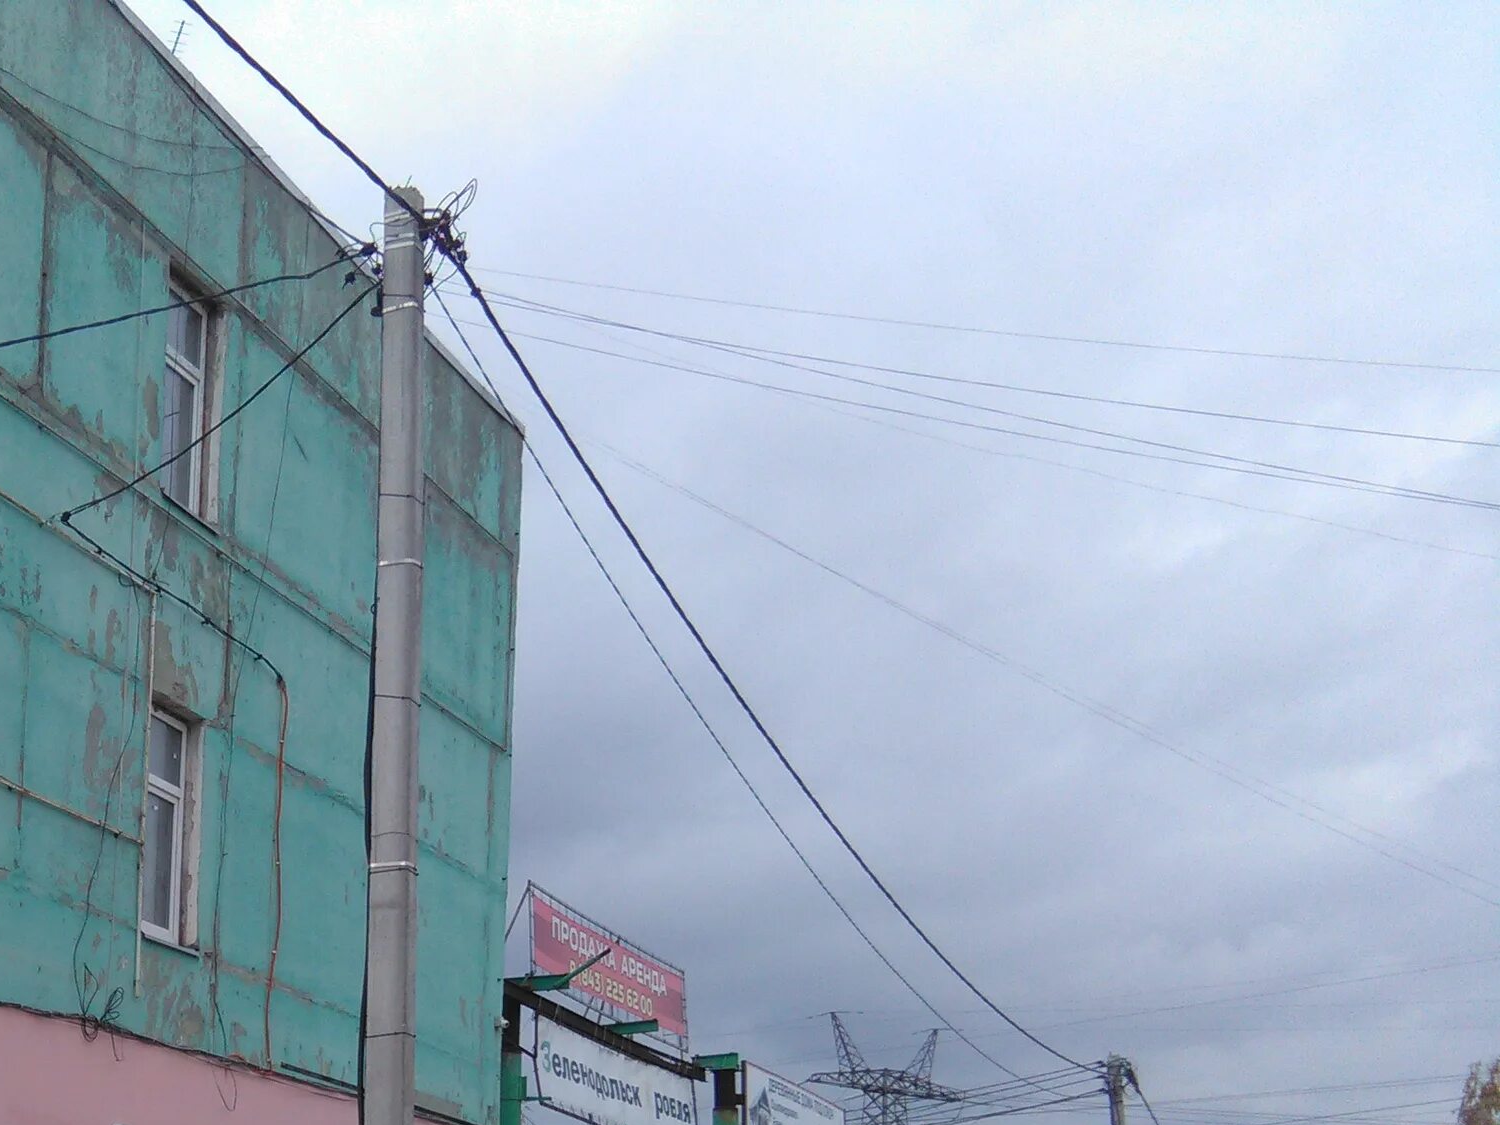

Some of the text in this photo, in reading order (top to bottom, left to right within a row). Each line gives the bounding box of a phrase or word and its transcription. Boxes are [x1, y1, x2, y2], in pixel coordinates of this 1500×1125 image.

[551, 915, 668, 997] ПРОДАЖА АРЕНДА
[606, 977, 625, 1002] 225
[626, 988, 639, 1010] 62
[639, 994, 653, 1017] 00
[540, 1040, 642, 1108] Зеленодольск
